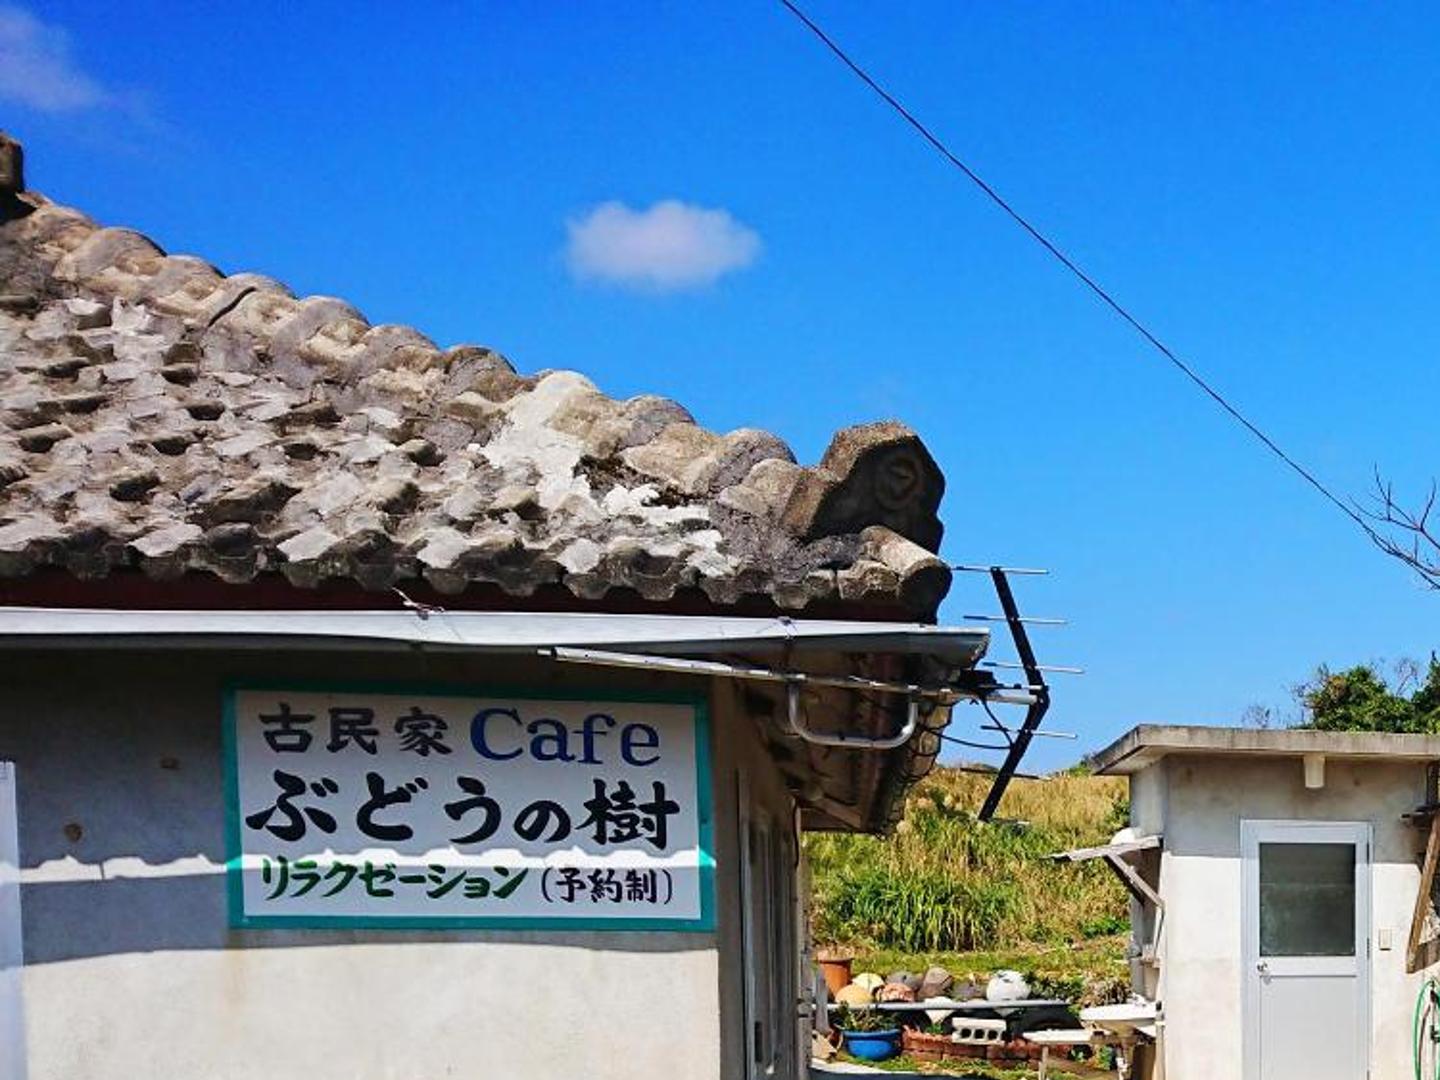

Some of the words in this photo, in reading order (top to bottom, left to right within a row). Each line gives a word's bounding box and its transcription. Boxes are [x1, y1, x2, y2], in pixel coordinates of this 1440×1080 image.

[259, 702, 453, 757] 古民家
[469, 707, 660, 766] Cafe
[245, 769, 681, 849] ぶどうの樹
